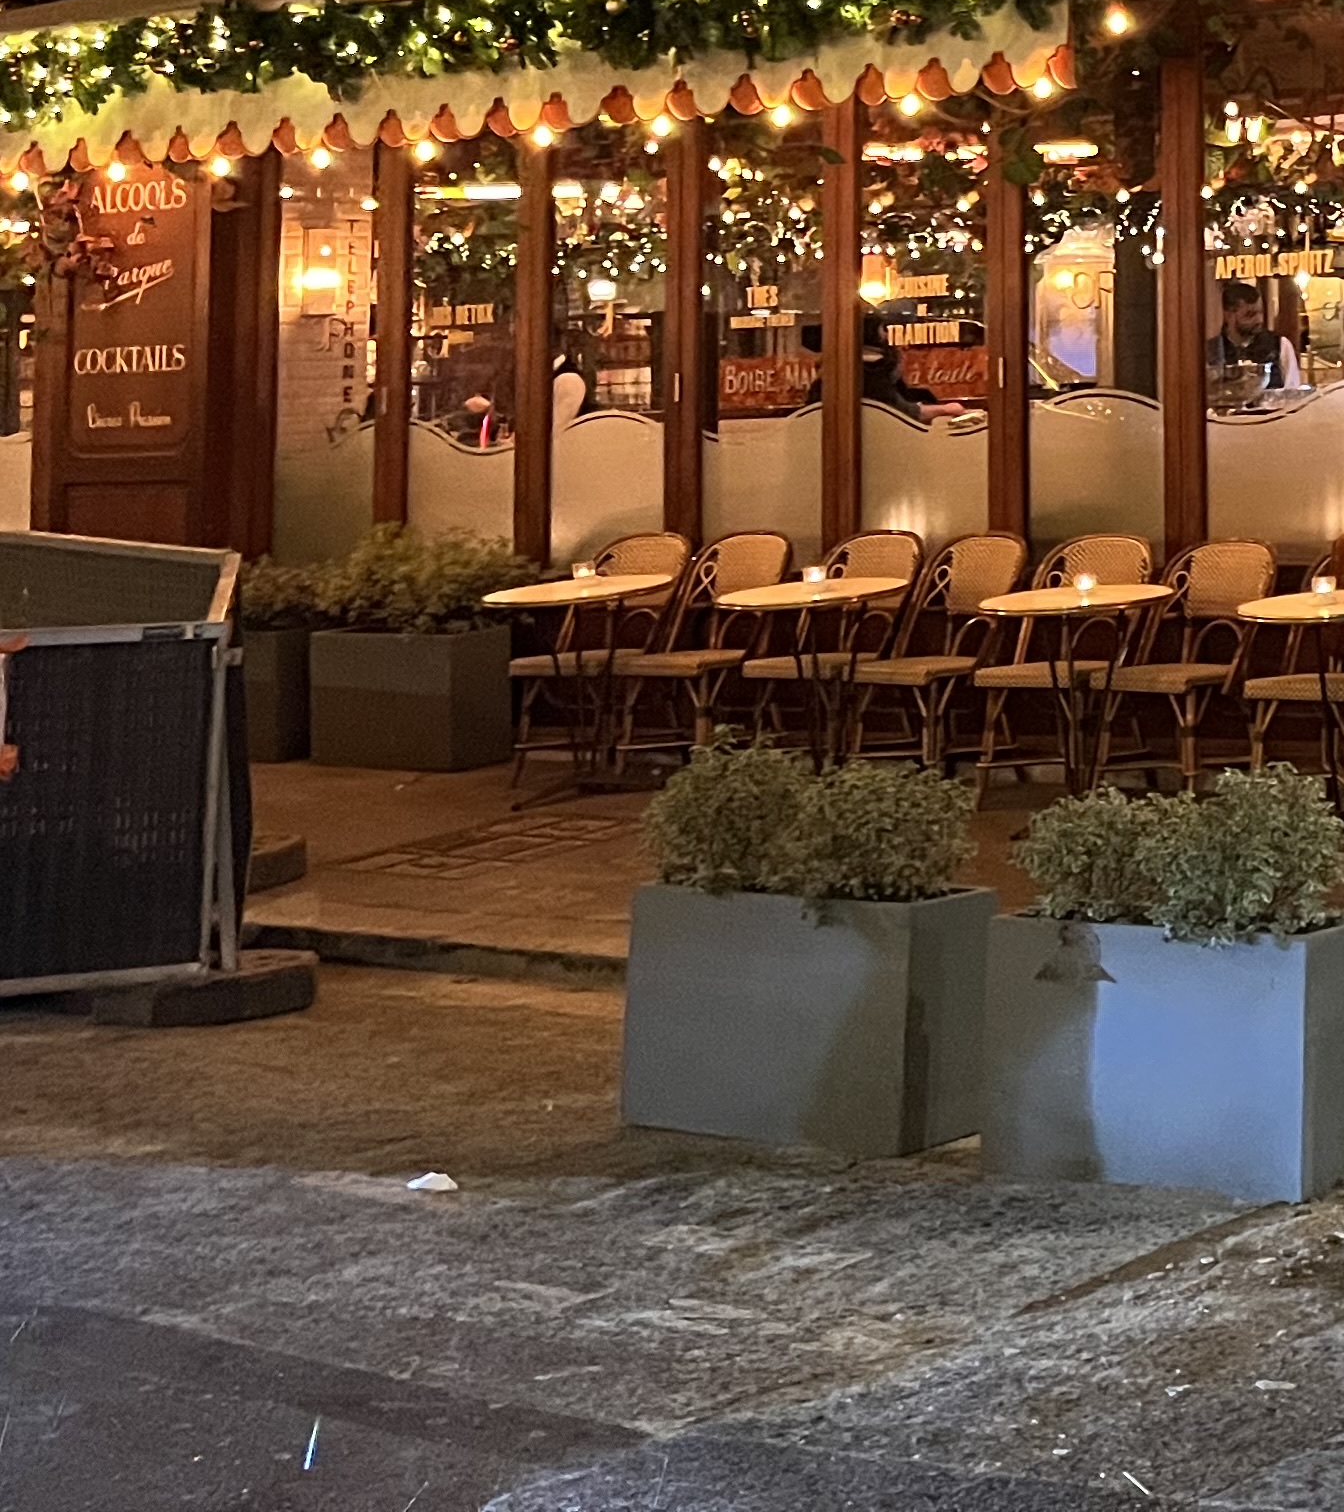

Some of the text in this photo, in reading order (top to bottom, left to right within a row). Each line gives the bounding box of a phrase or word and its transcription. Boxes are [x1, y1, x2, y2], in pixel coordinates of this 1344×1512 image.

[90, 178, 187, 214] ALCOOLS
[126, 221, 146, 245] de
[1215, 254, 1274, 280] APEROL
[886, 322, 960, 347] TRADITION
[74, 344, 186, 375] COCKTAILS
